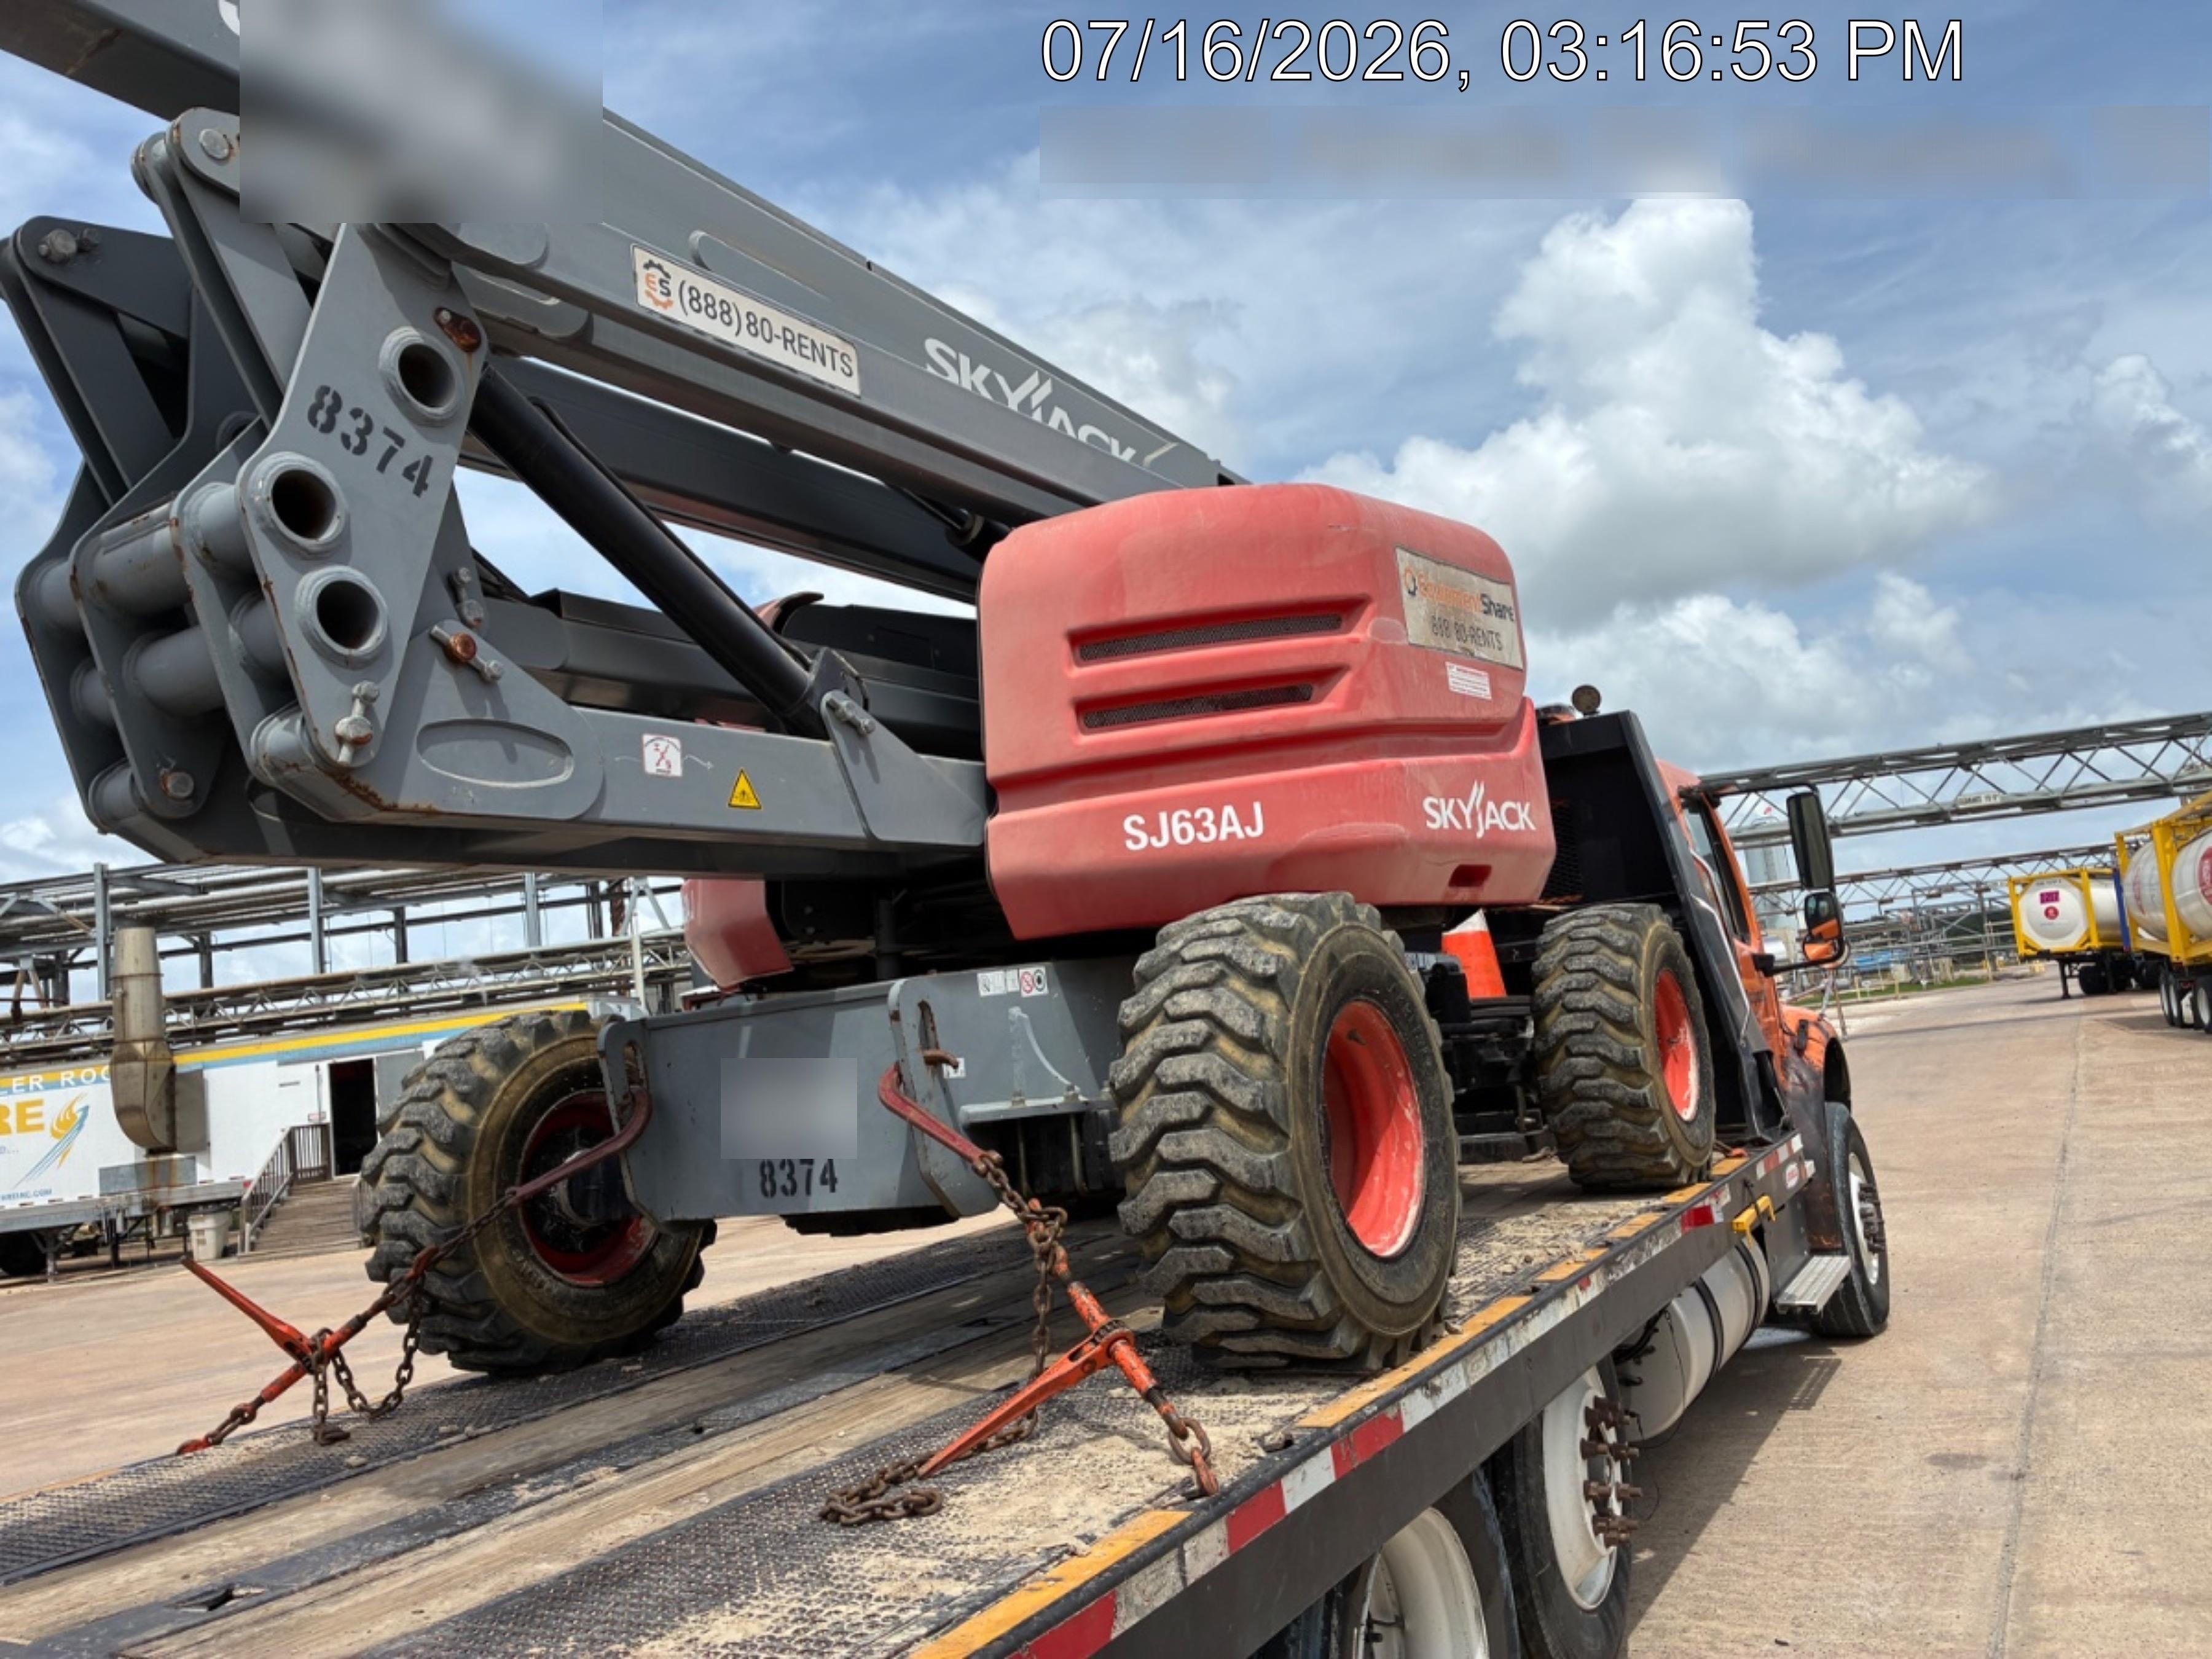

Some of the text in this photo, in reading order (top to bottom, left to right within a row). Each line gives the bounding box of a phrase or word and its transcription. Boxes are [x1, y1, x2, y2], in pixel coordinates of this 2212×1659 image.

[307, 385, 433, 498] 8374
[1123, 801, 1265, 850] SJ63AJ
[1422, 779, 1536, 839] SKYJACK
[759, 1158, 839, 1199] 8374
